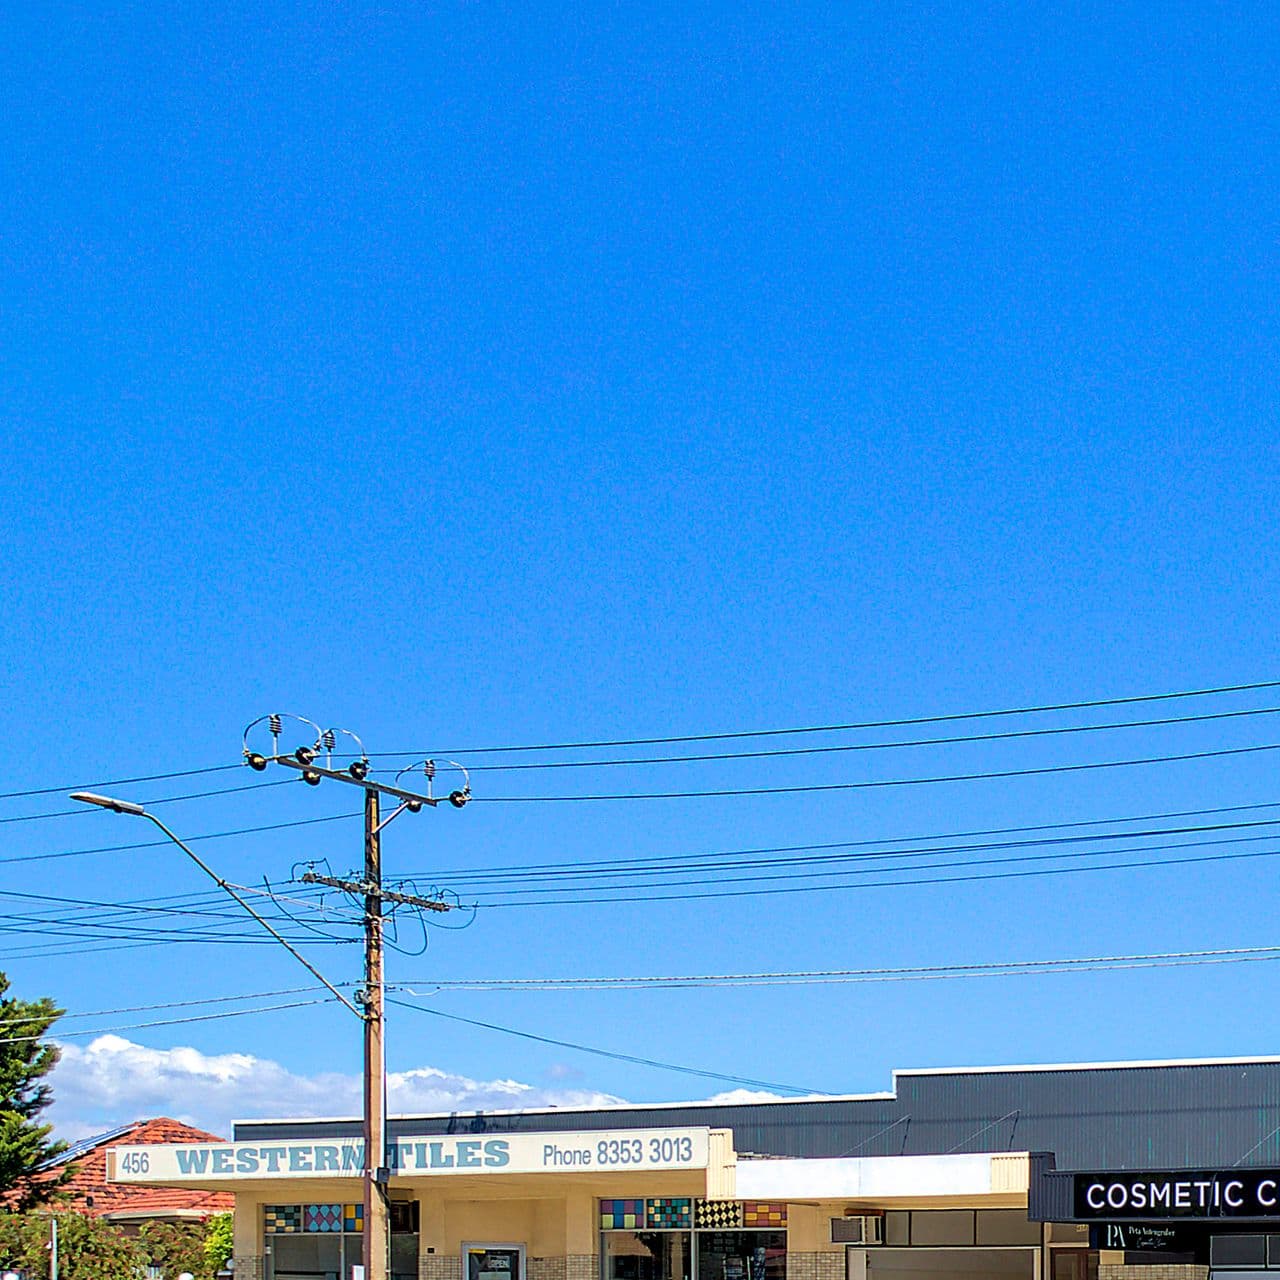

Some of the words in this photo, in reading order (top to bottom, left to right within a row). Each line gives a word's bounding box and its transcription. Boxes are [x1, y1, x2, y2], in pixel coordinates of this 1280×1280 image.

[122, 1152, 150, 1174] 456
[175, 1145, 365, 1174] WESTERN
[386, 1140, 510, 1168] TILES
[543, 1144, 591, 1165] Phone
[597, 1140, 643, 1165] 8353
[649, 1137, 692, 1162] 3013
[1087, 1181, 1244, 1208] COSMETIC
